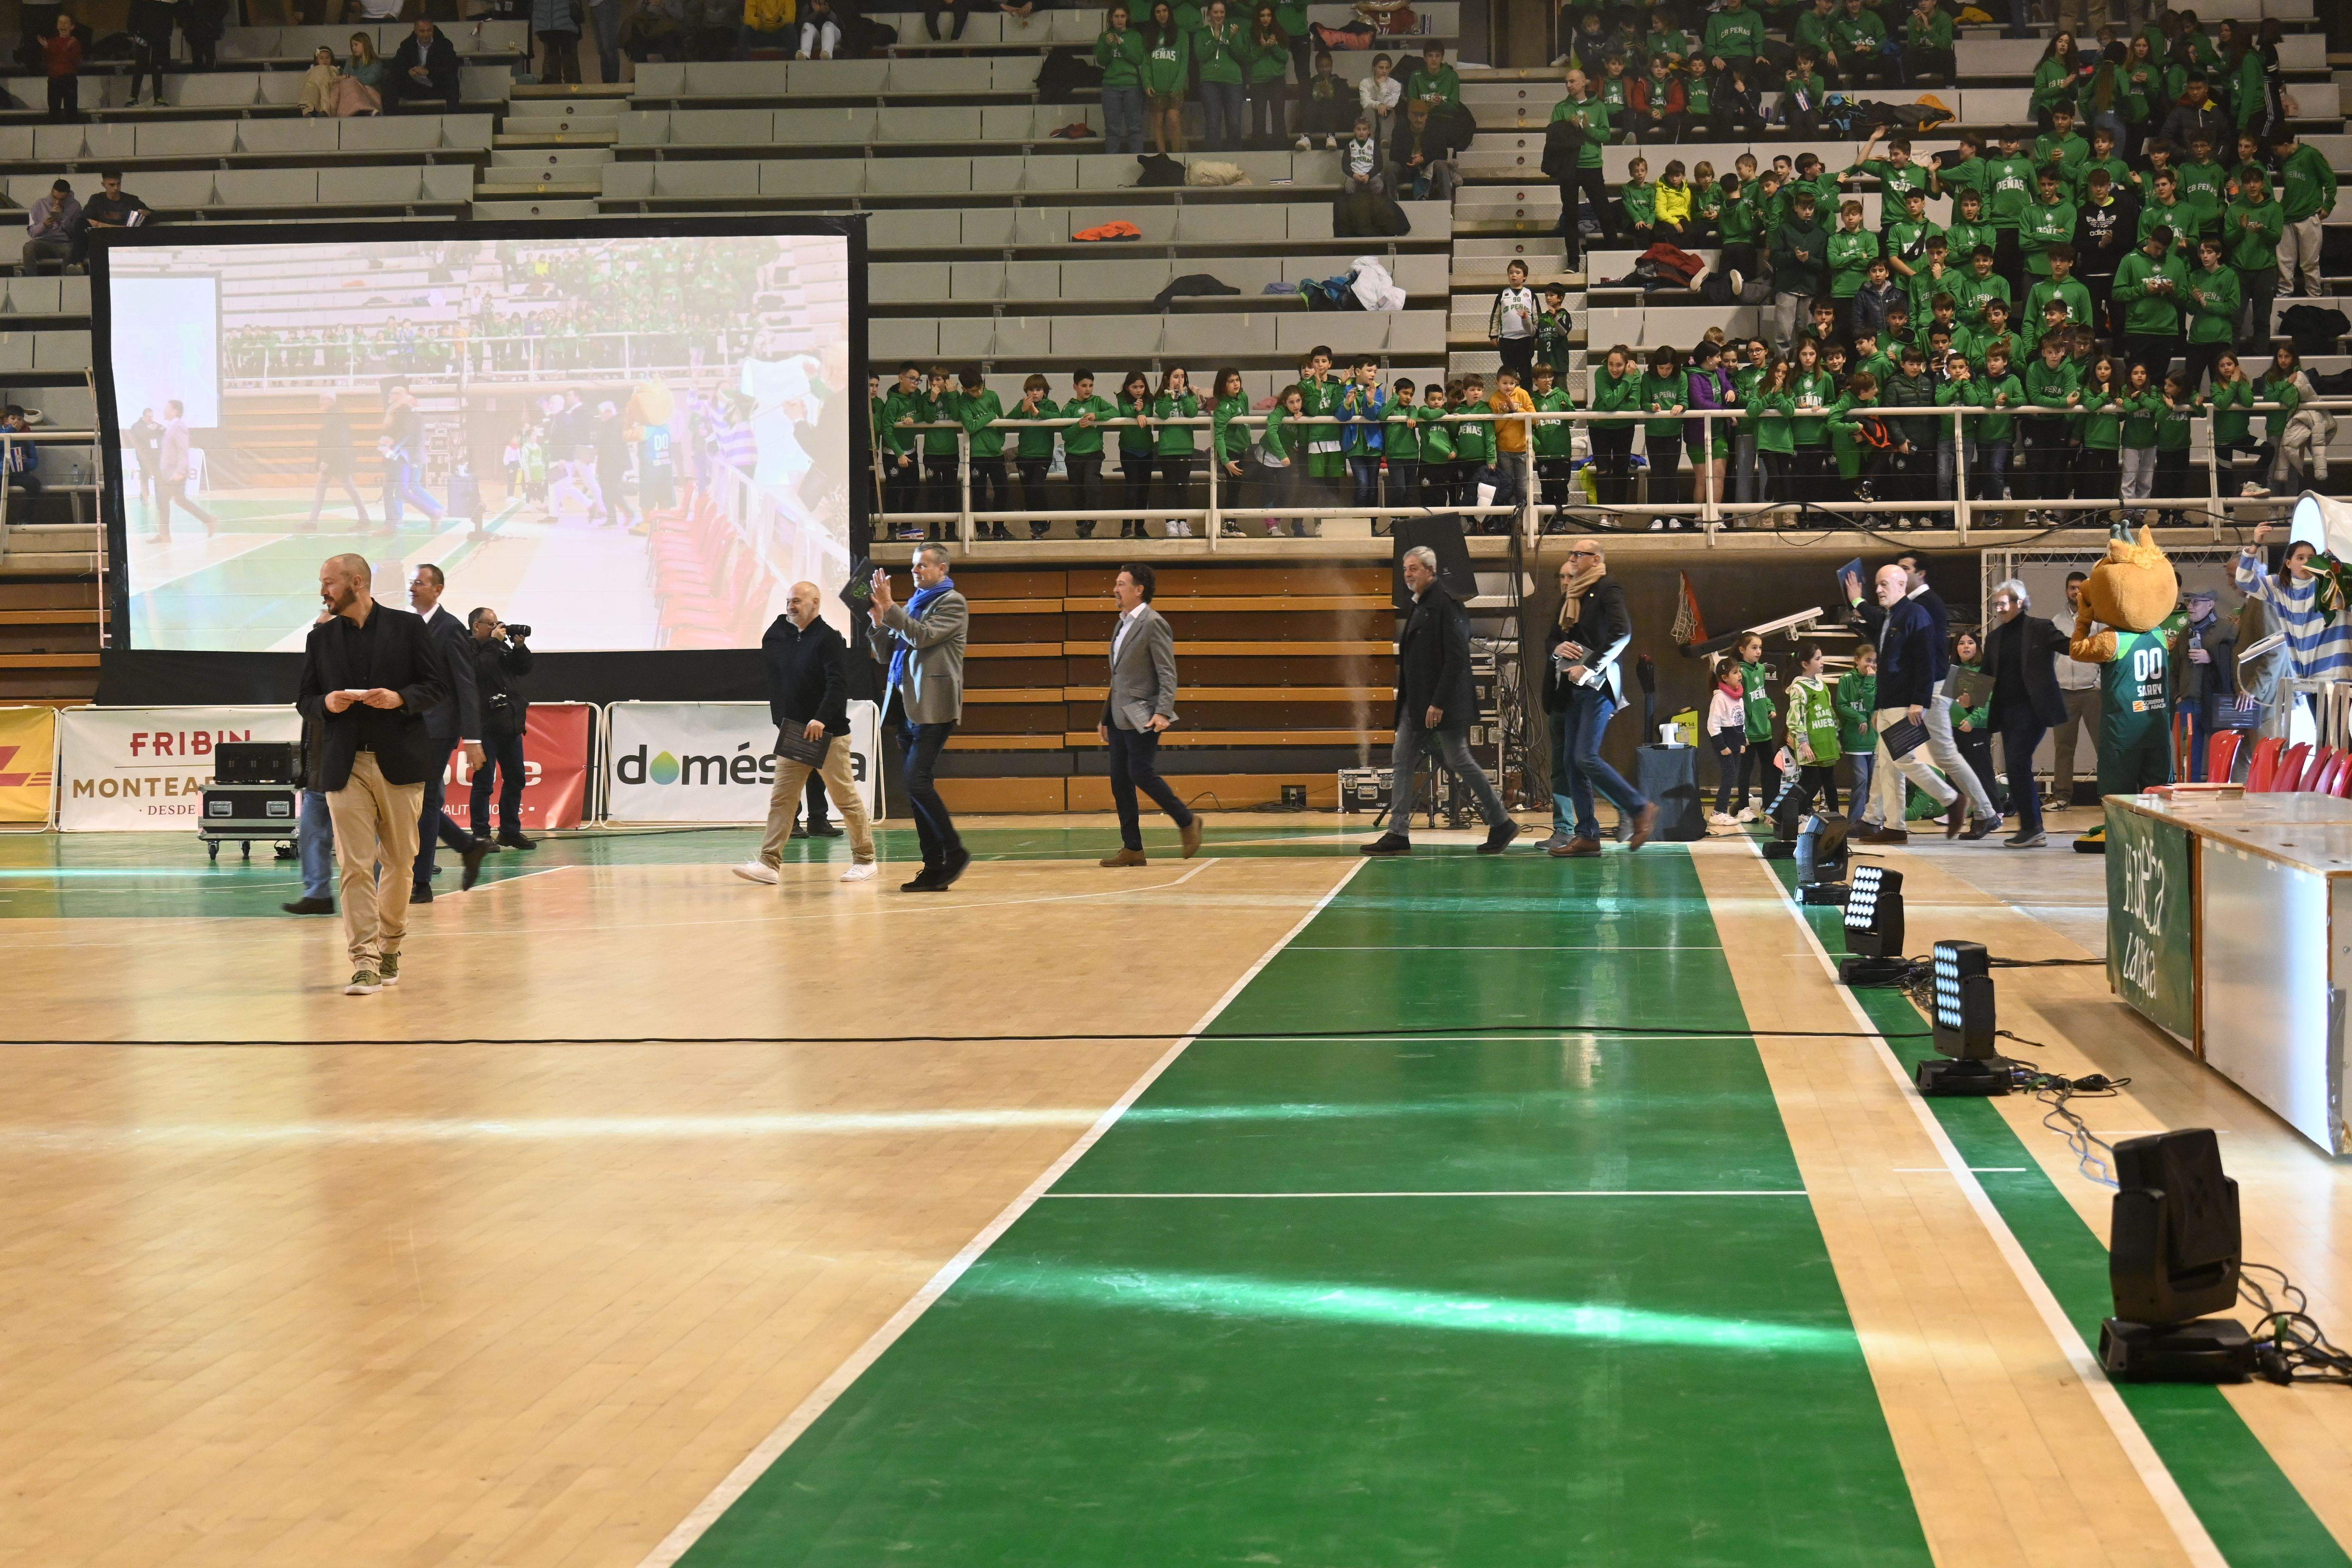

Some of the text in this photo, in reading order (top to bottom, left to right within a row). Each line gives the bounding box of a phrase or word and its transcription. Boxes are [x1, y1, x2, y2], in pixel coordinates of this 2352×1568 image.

[1996, 178, 2024, 193] PEÑAS
[1977, 293, 1993, 302] PEÑ
[1546, 341, 1551, 352] 2
[2134, 647, 2162, 682] 00
[2137, 683, 2162, 697] SARRY
[1815, 708, 1832, 719] MAG
[1812, 718, 1836, 730] HUES
[617, 741, 866, 785] domésa
[147, 804, 195, 816] DESDE
